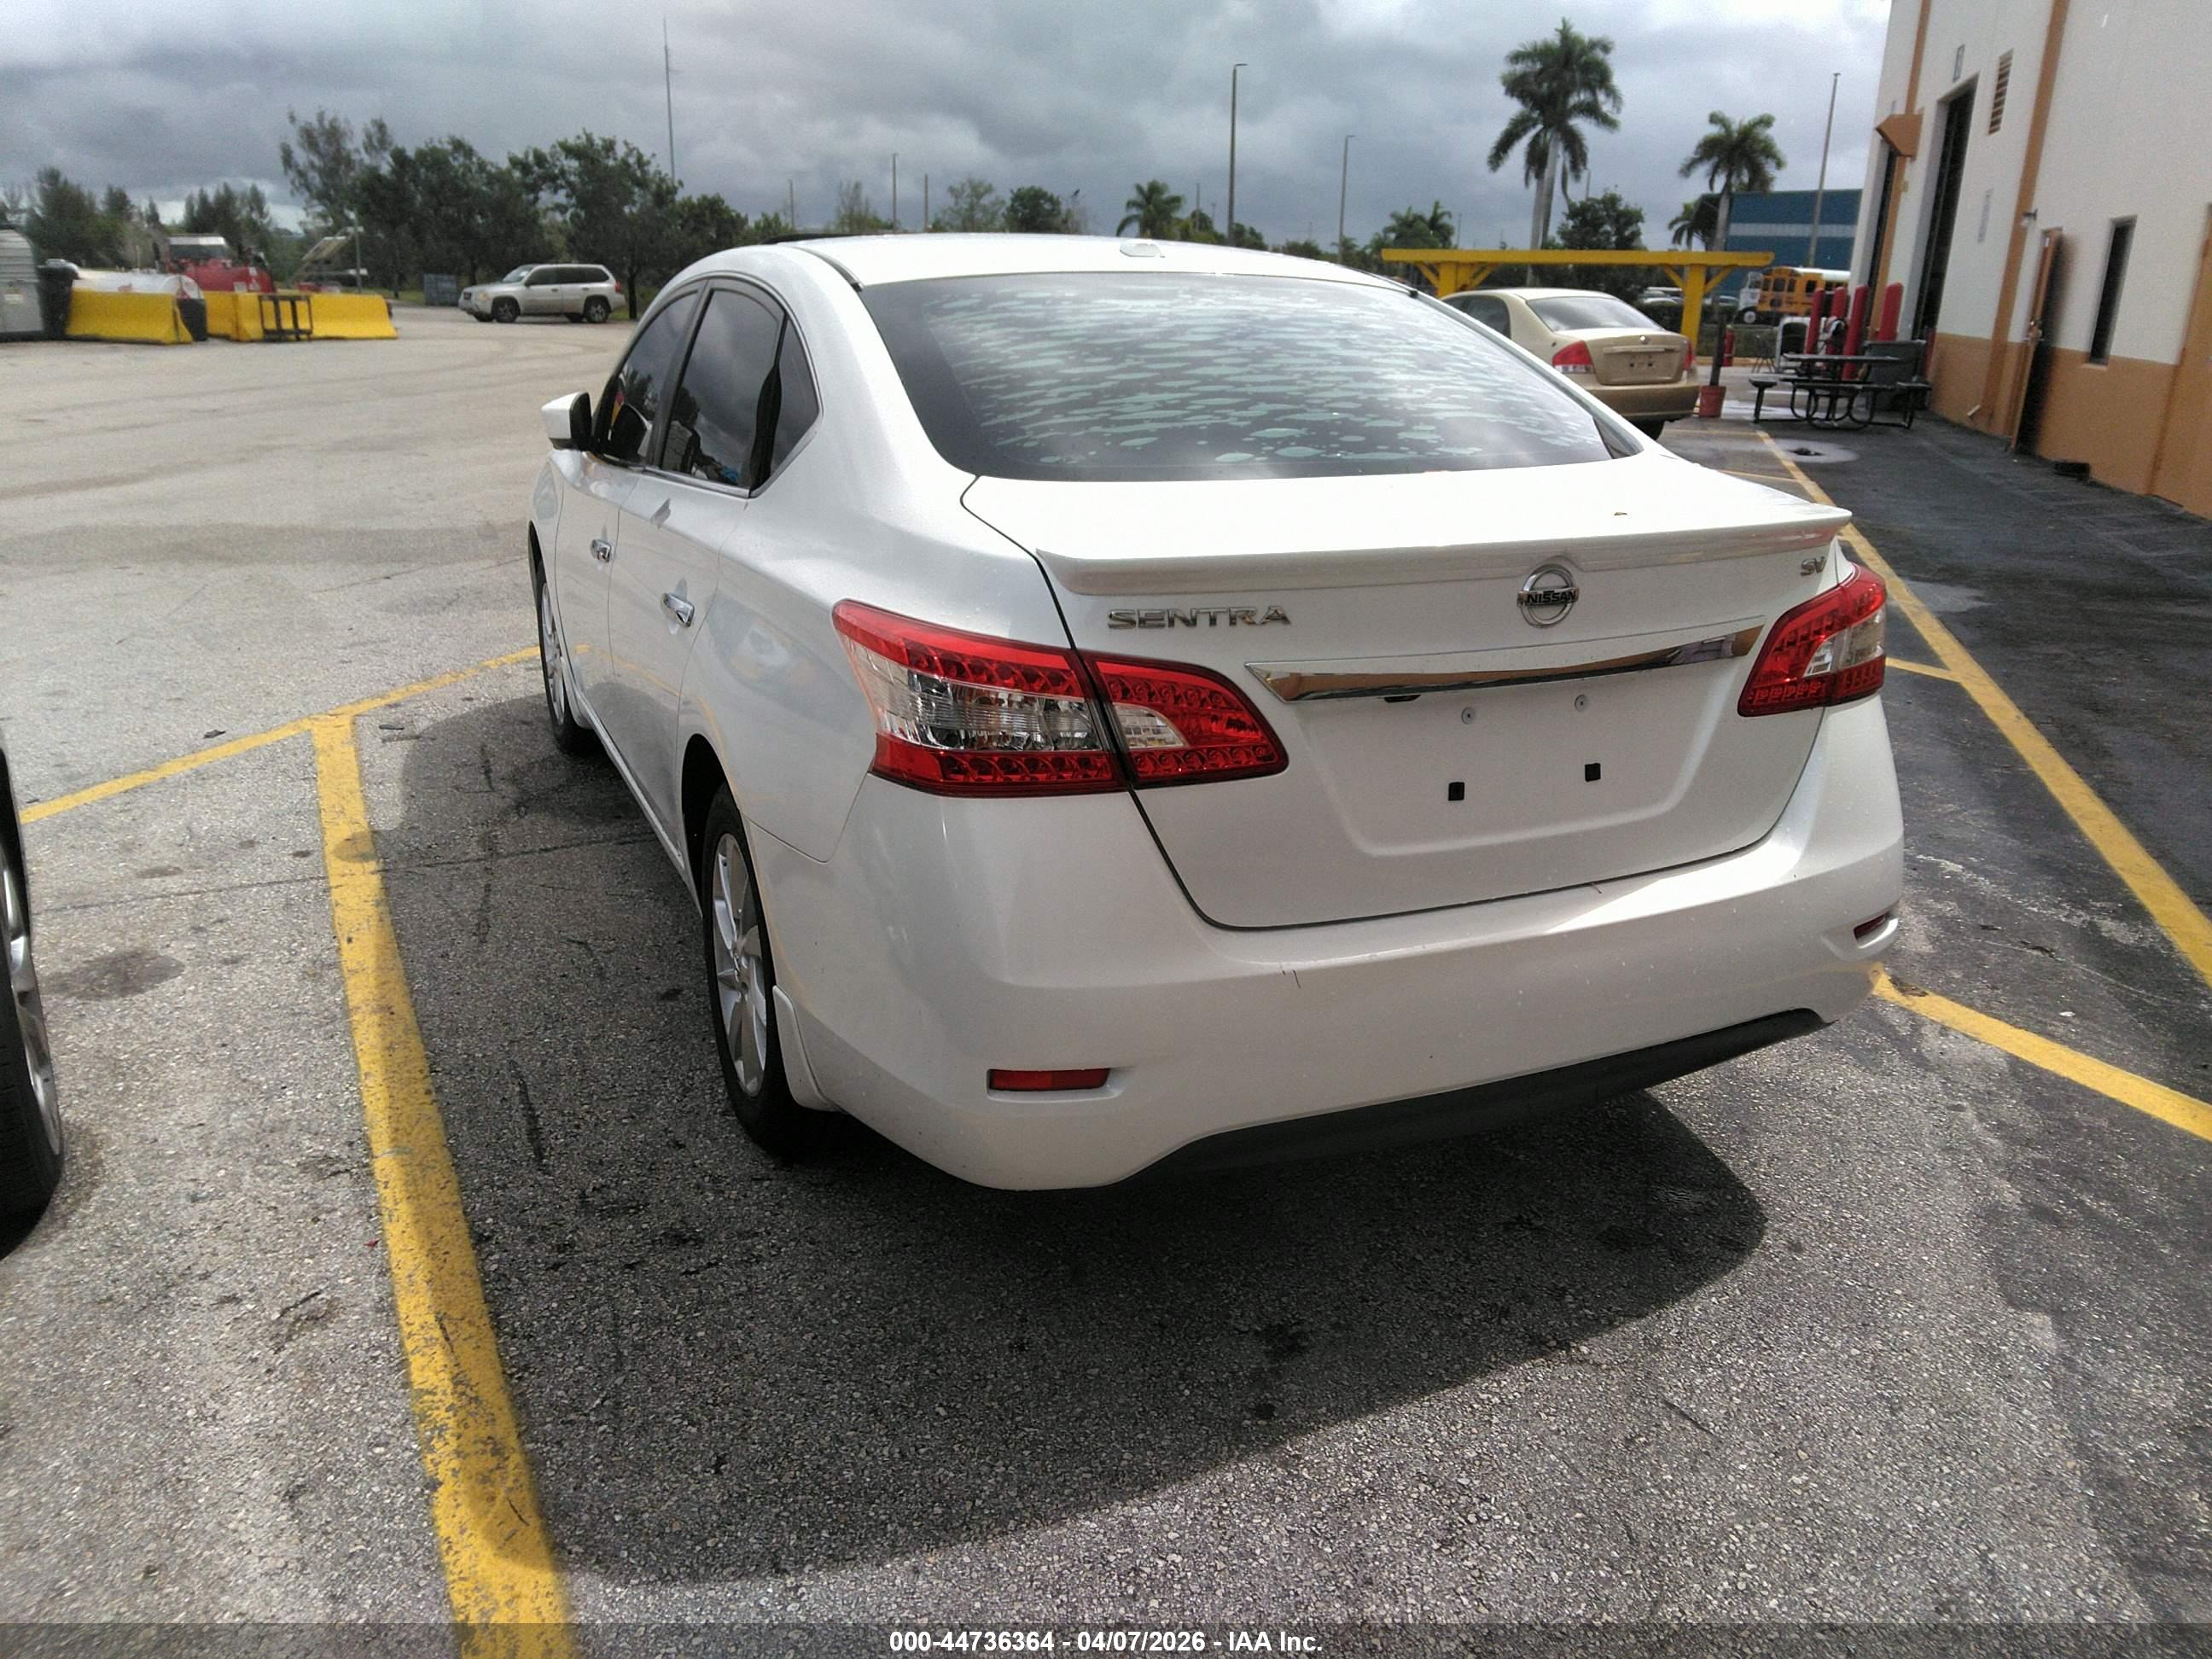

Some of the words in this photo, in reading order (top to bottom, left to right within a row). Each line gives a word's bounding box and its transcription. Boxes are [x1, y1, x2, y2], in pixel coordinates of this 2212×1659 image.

[1801, 556, 1827, 576] SV
[1527, 590, 1577, 603] NISSAN
[1108, 606, 1291, 629] SENTRA
